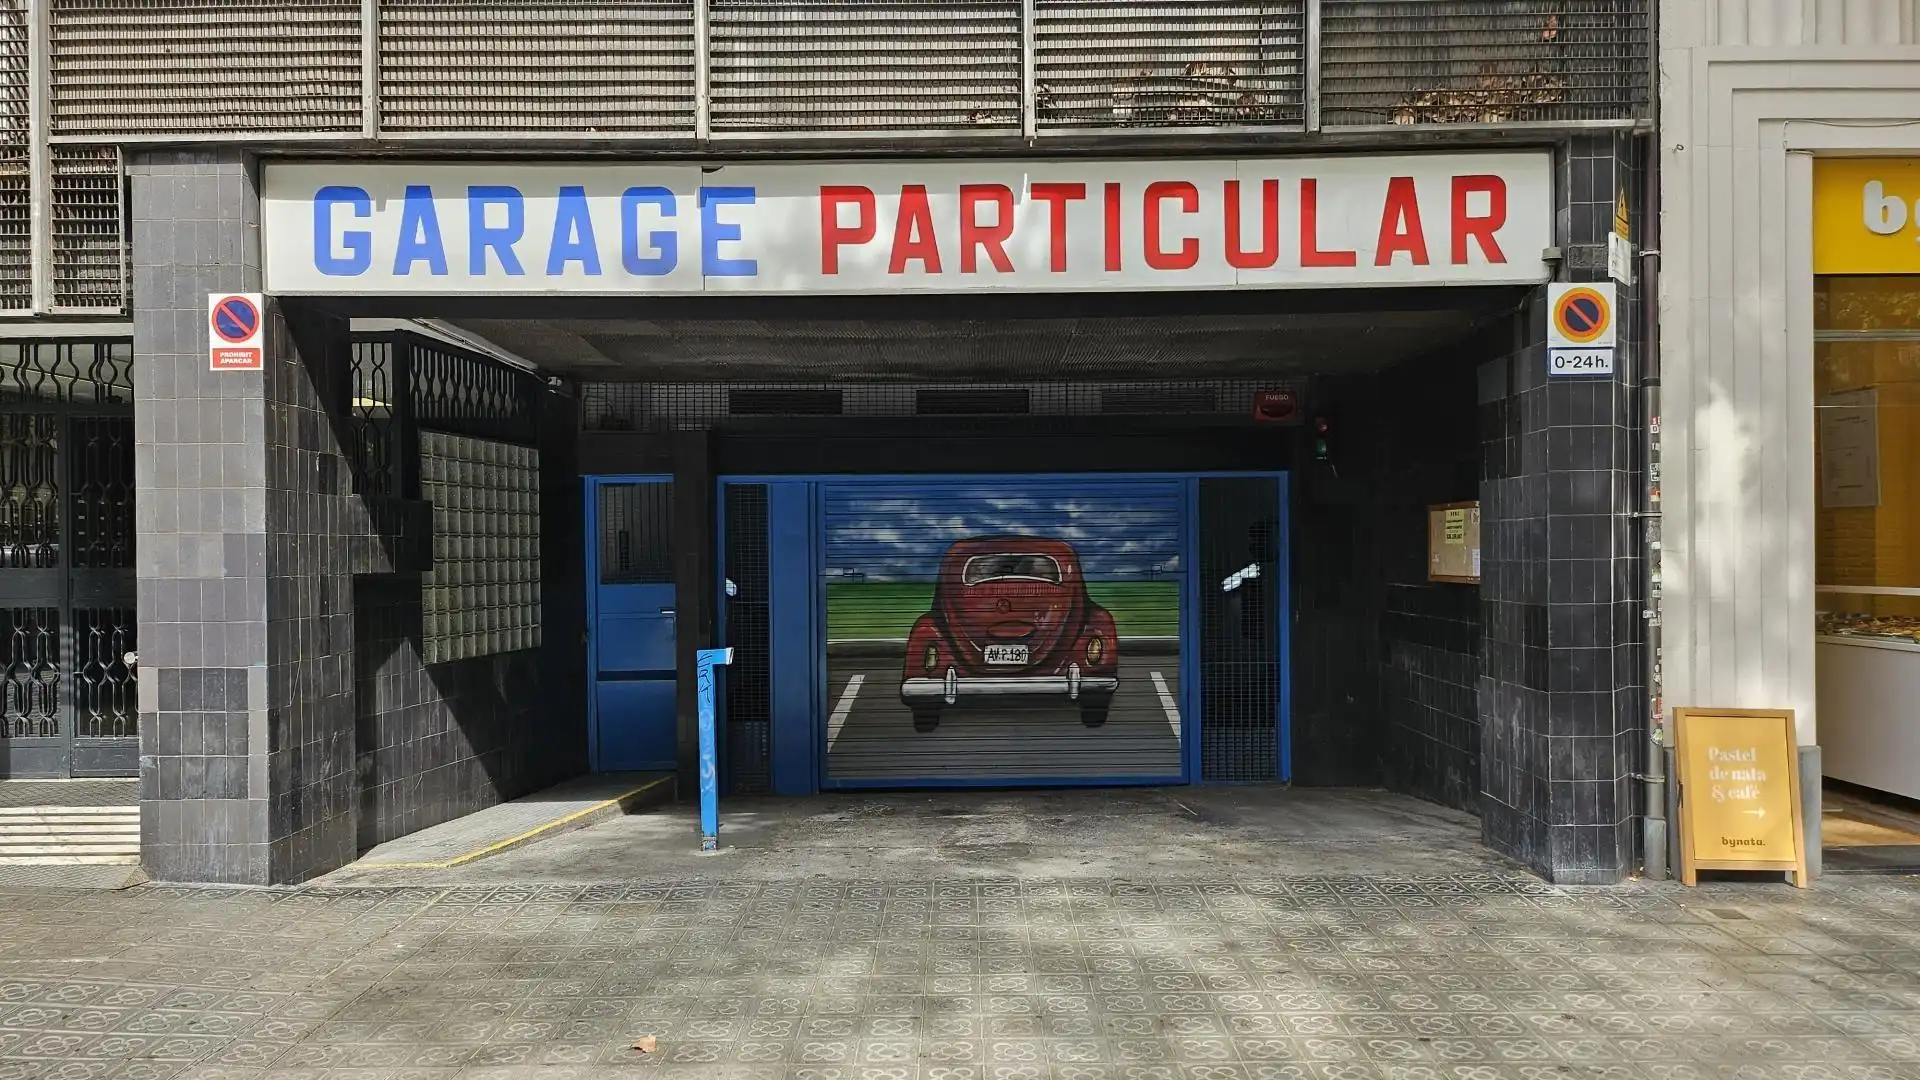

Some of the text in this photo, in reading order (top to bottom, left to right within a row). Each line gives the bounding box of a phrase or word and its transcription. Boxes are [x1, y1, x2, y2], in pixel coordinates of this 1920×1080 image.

[313, 185, 758, 277] GARAGE
[820, 174, 1509, 275] PARTICULAR
[1708, 746, 1757, 762] Pastel
[1709, 766, 1767, 782] de nata
[1711, 785, 1761, 802] & café
[1721, 836, 1766, 848] bynata.
